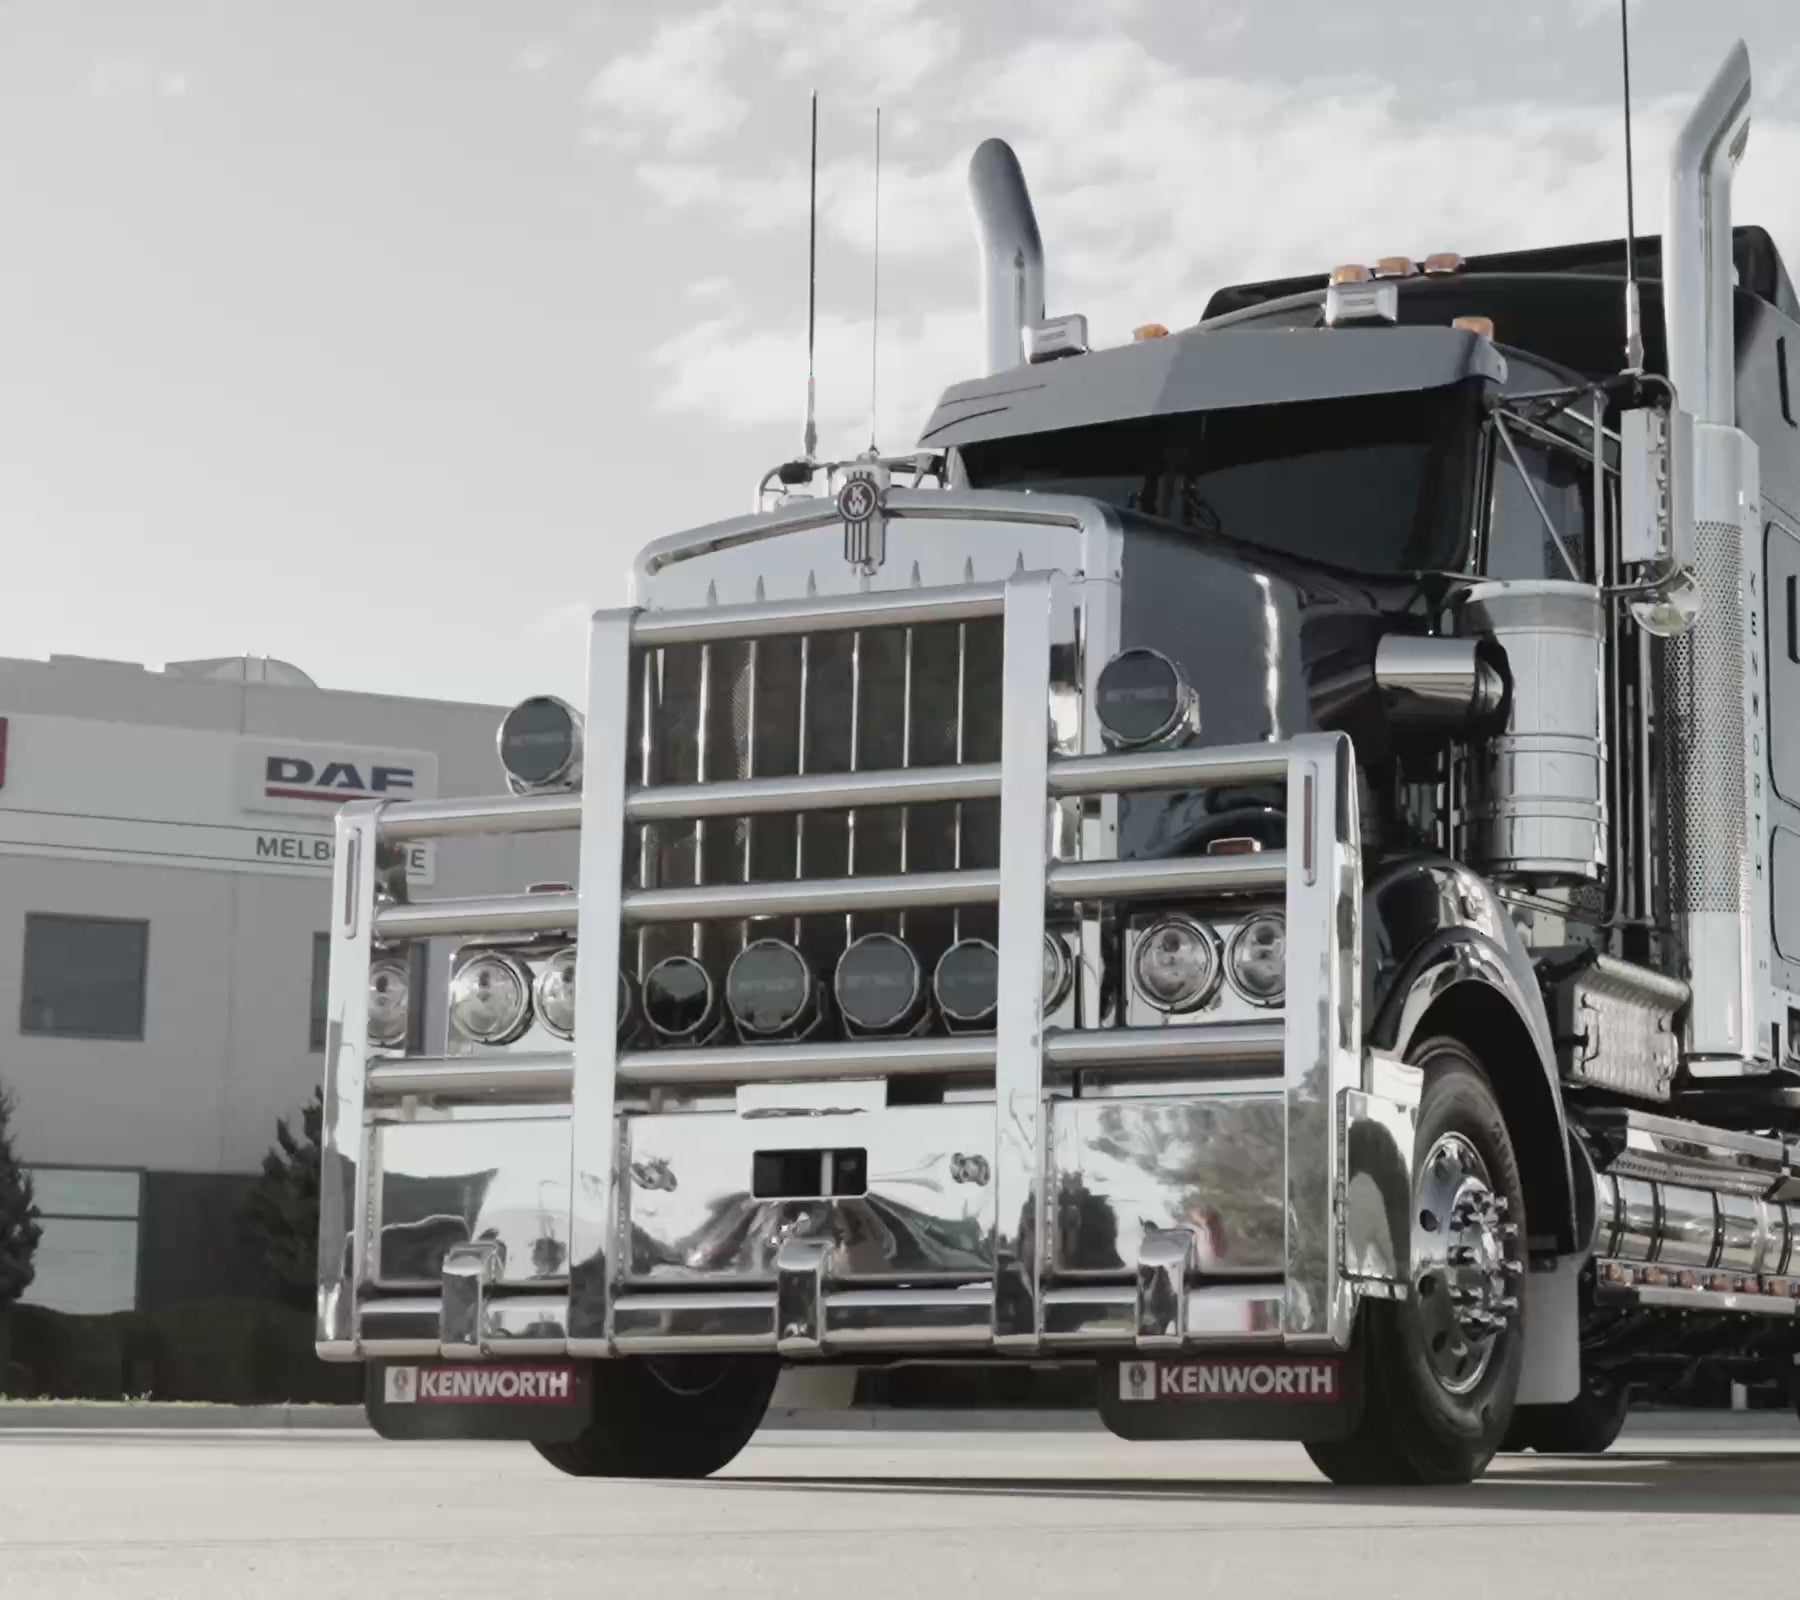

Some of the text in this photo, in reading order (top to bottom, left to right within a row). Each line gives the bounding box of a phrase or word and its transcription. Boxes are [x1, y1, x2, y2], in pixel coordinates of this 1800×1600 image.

[266, 756, 414, 791] DAF
[256, 836, 426, 868] MELBE
[420, 1371, 569, 1397] KENWORTH
[1161, 1365, 1334, 1394] KENWORTH
